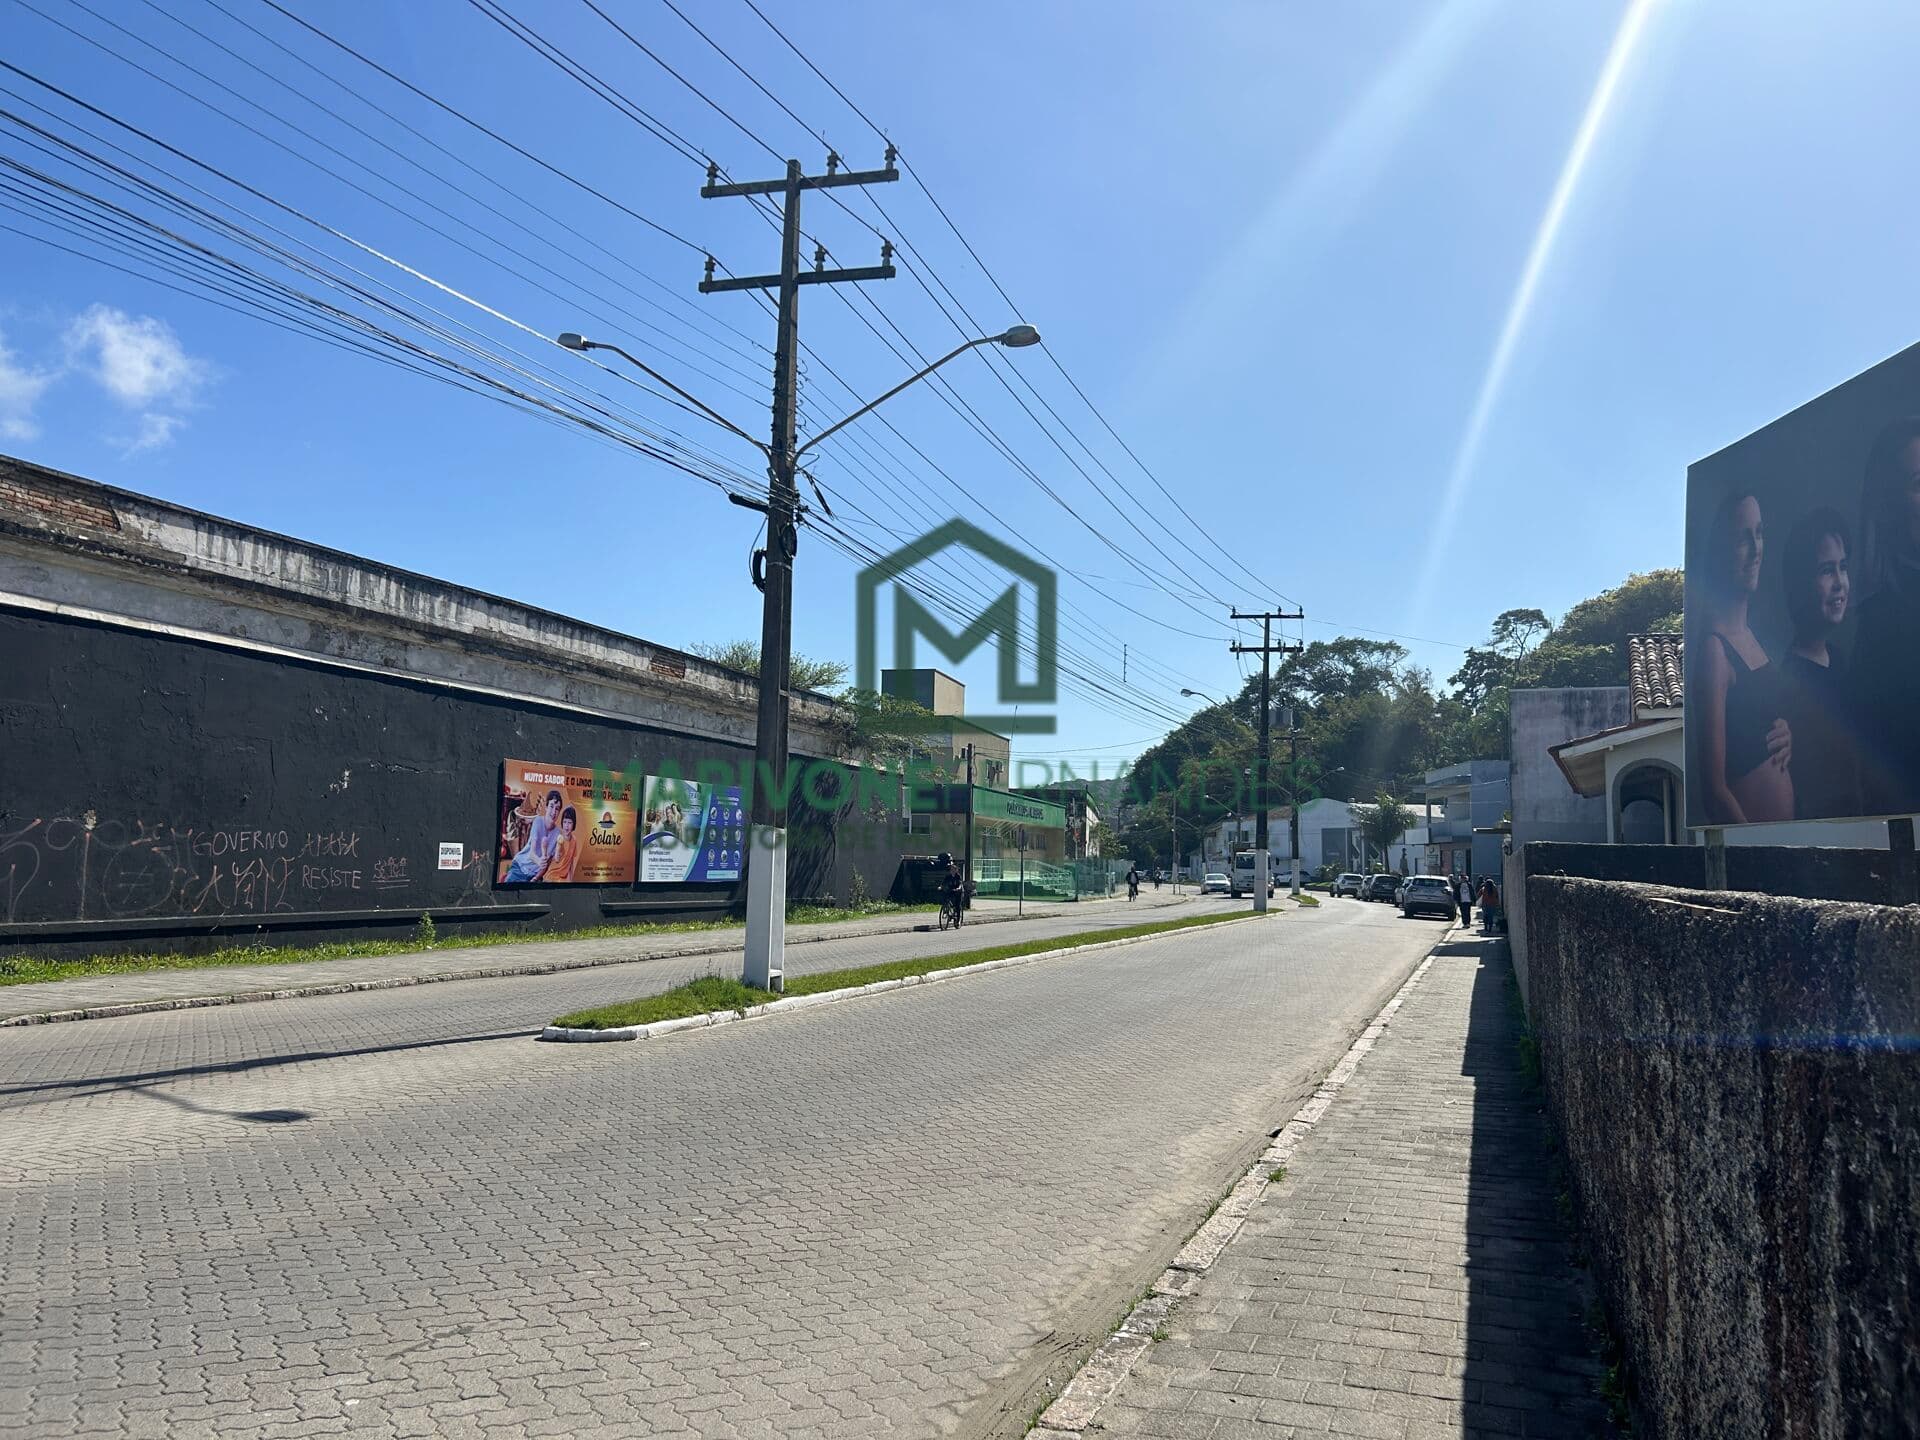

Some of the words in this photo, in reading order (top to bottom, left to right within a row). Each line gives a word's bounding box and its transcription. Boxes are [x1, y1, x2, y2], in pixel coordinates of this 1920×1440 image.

[524, 772, 543, 783] MUITO
[544, 774, 565, 785] SABOR
[582, 789, 607, 800] MERO
[193, 830, 288, 856] GOVERNO
[589, 828, 622, 846] Solare
[302, 864, 362, 890] RESISTE
